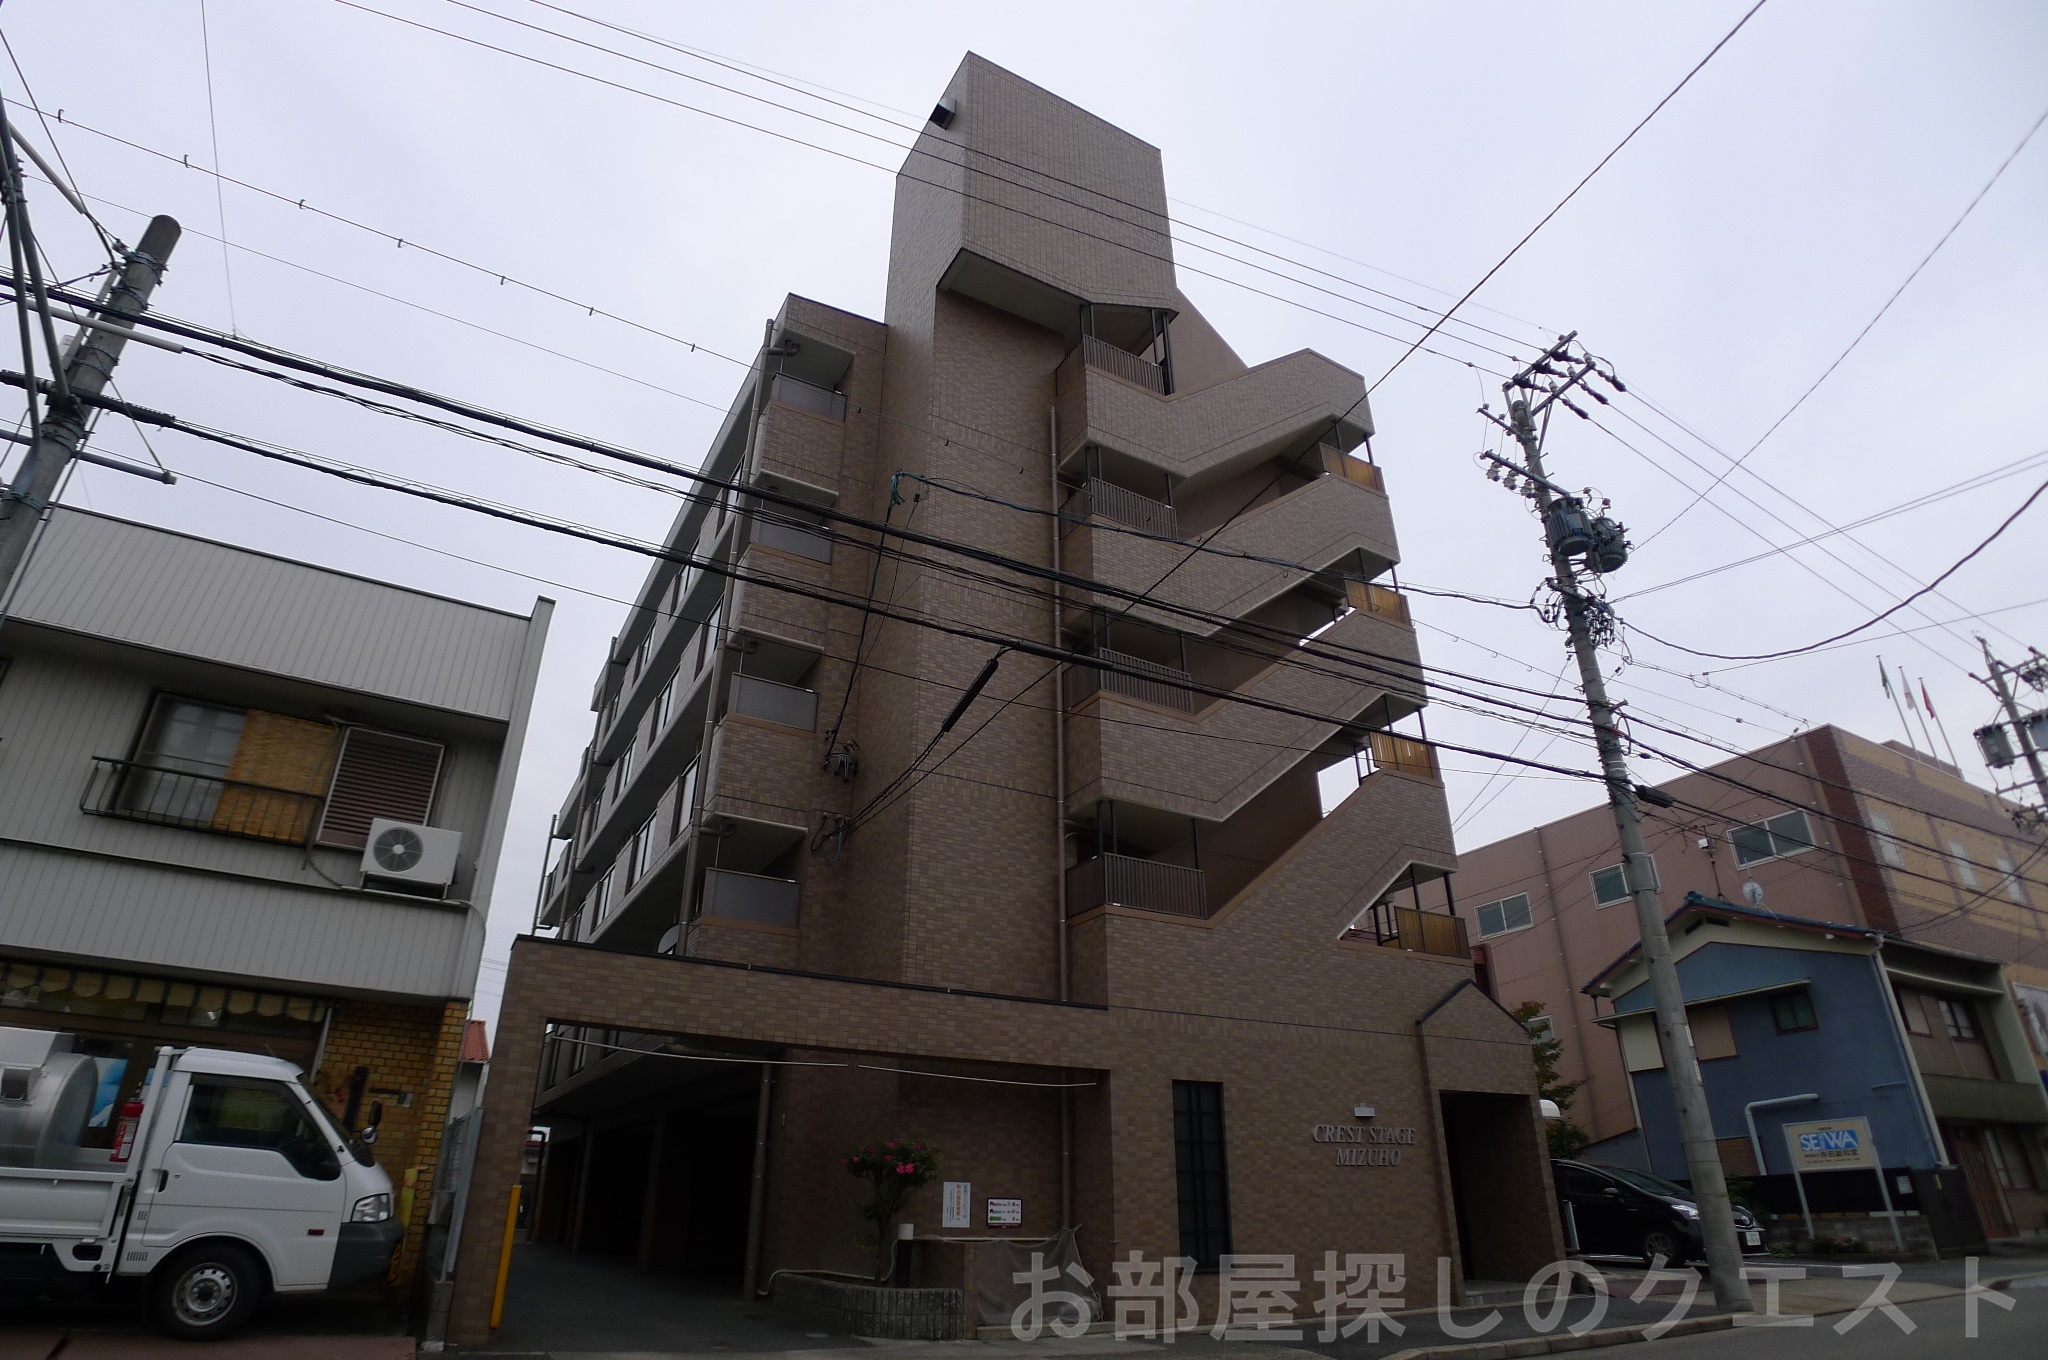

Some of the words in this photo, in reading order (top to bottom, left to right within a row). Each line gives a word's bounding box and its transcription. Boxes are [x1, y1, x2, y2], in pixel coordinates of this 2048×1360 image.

[1313, 1125, 1365, 1143] CREST
[1369, 1127, 1416, 1144] STAGE
[1335, 1148, 1402, 1166] MIZUHO
